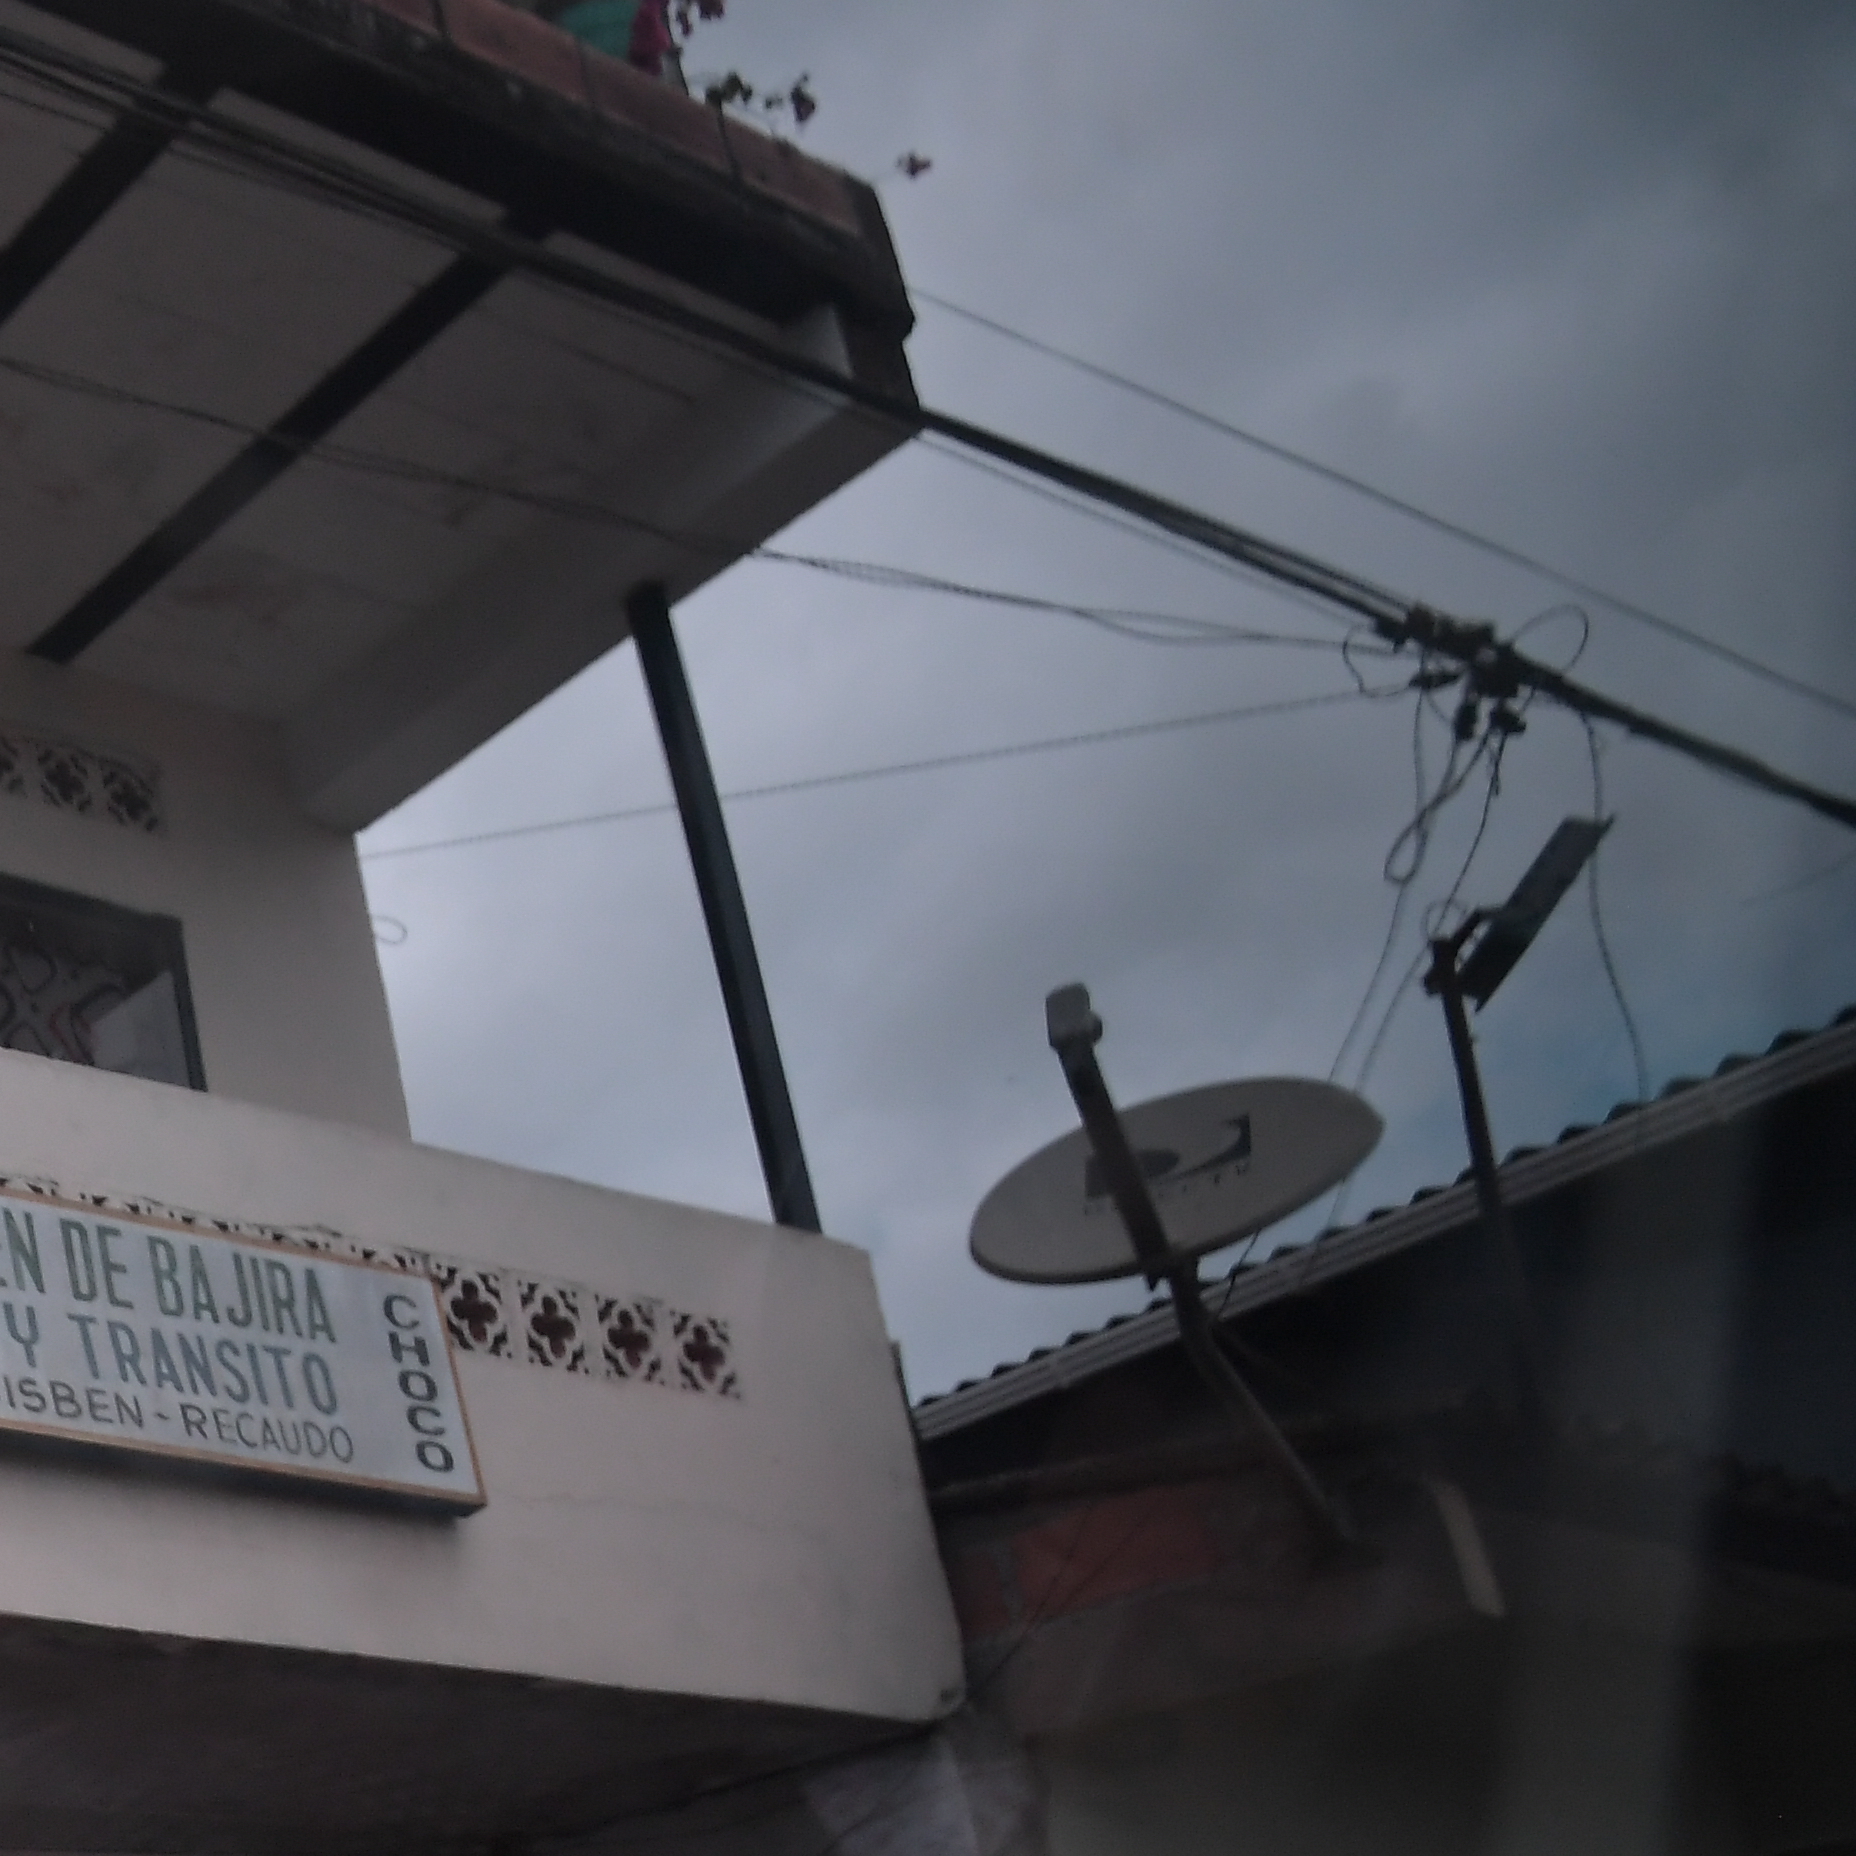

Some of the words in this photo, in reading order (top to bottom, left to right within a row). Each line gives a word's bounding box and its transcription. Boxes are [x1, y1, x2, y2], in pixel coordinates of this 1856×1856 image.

[59, 1217, 134, 1310] DE
[147, 1234, 338, 1344] BAJIRA
[2, 1301, 39, 1369] Y
[67, 1311, 339, 1417] TRANSITO
[382, 1293, 455, 1474] CHOCO
